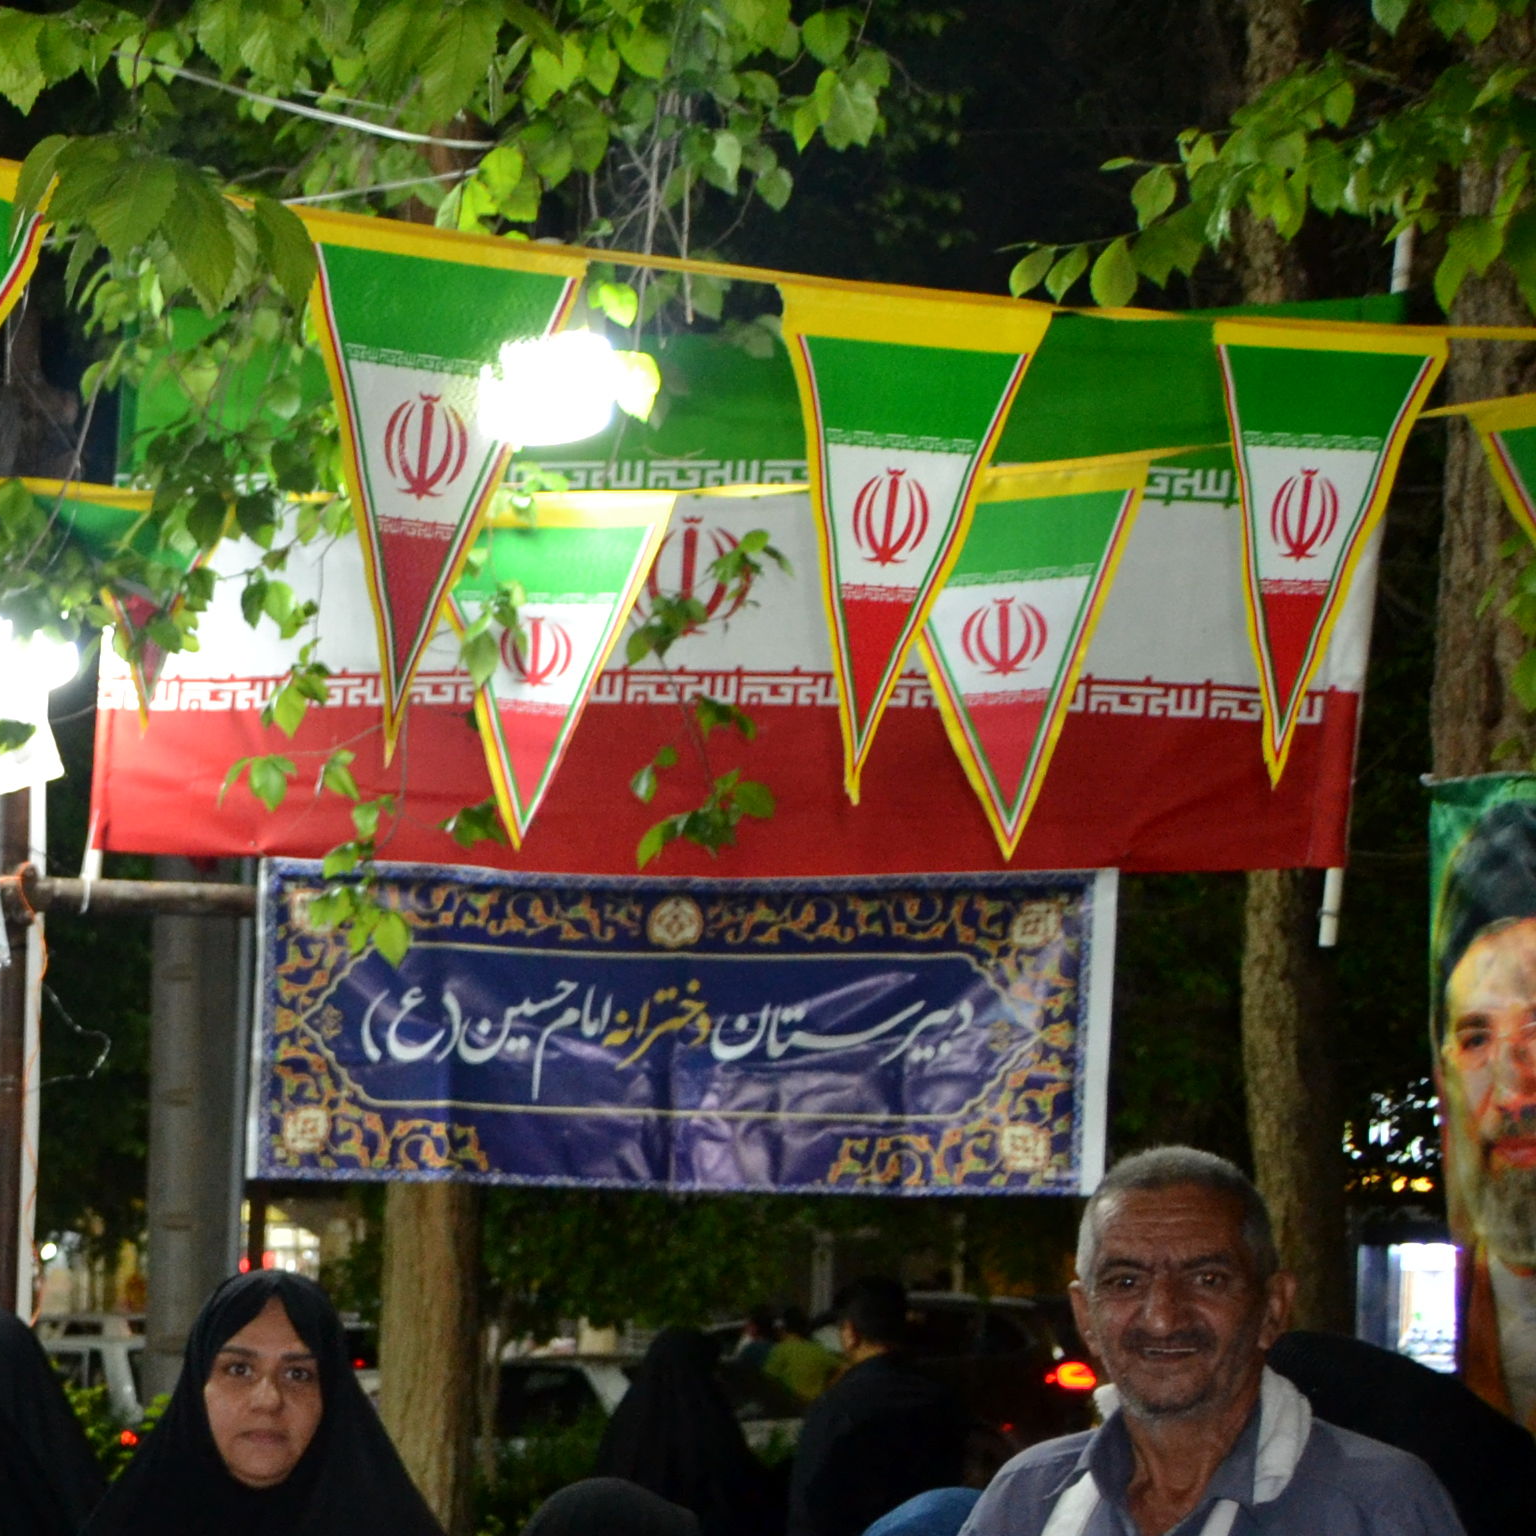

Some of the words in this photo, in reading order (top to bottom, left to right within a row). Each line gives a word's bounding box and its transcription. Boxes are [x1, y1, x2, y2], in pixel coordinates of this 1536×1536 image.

[531, 984, 613, 1101] امام
[601, 979, 713, 1072] دخترانه
[709, 999, 974, 1066] دبیرستان
